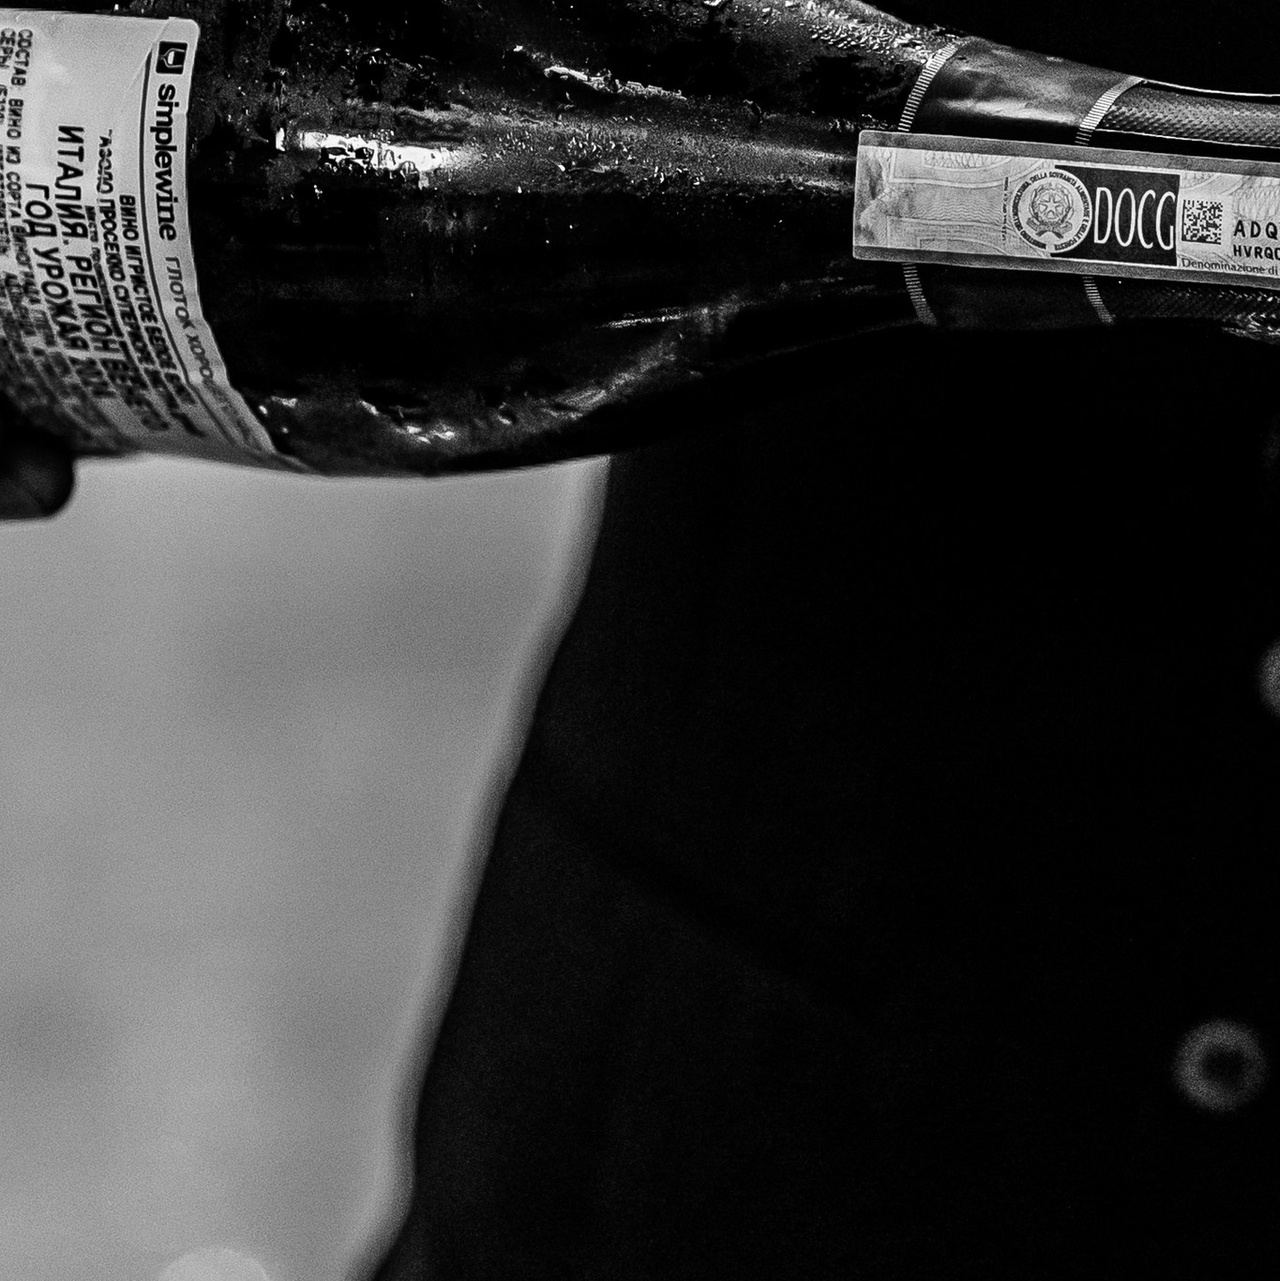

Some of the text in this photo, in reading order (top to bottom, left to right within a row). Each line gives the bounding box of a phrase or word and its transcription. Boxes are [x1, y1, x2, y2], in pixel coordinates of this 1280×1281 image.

[7, 99, 24, 139] ВИНО
[6, 146, 21, 164] ИЗ
[55, 126, 88, 245] ИТАЛИЯ.
[150, 84, 180, 241] simplewine
[6, 172, 21, 218] СОРТА
[22, 184, 57, 237] ГОД
[120, 194, 139, 241] ВИНО
[1093, 186, 1177, 252] DOCG
[98, 199, 126, 282] ПРОСЕККО
[1181, 258, 1266, 274] Denominazione
[1268, 266, 1279, 276] di
[33, 247, 89, 350] УРОЖАЯ
[66, 256, 121, 353] РЕГИОН
[125, 245, 158, 324] ИГРИСТОЕ
[165, 256, 196, 329] ГЛОТОК
